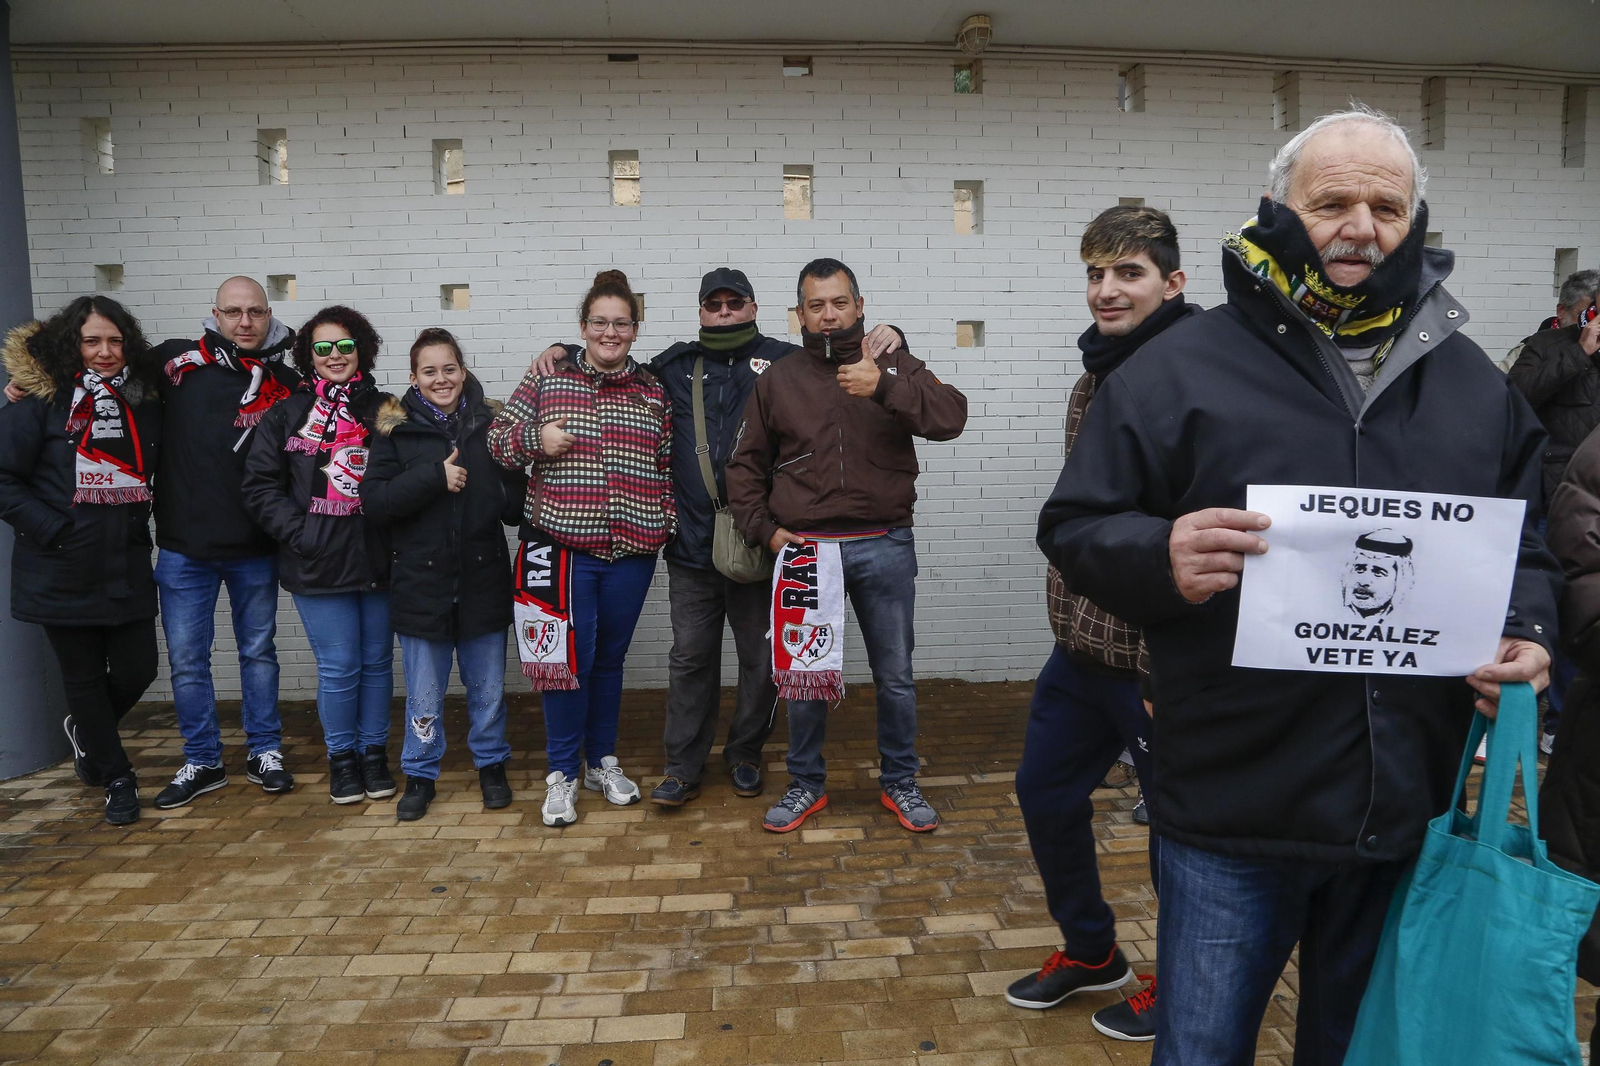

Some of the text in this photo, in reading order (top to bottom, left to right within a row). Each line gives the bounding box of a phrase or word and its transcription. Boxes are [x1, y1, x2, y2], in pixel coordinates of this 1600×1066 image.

[79, 472, 114, 485] 1924
[1300, 494, 1475, 522] JEQUES NO
[527, 541, 552, 587] RA
[1294, 619, 1440, 646] GONZÁLEZ
[1305, 647, 1418, 668] VETE YA
